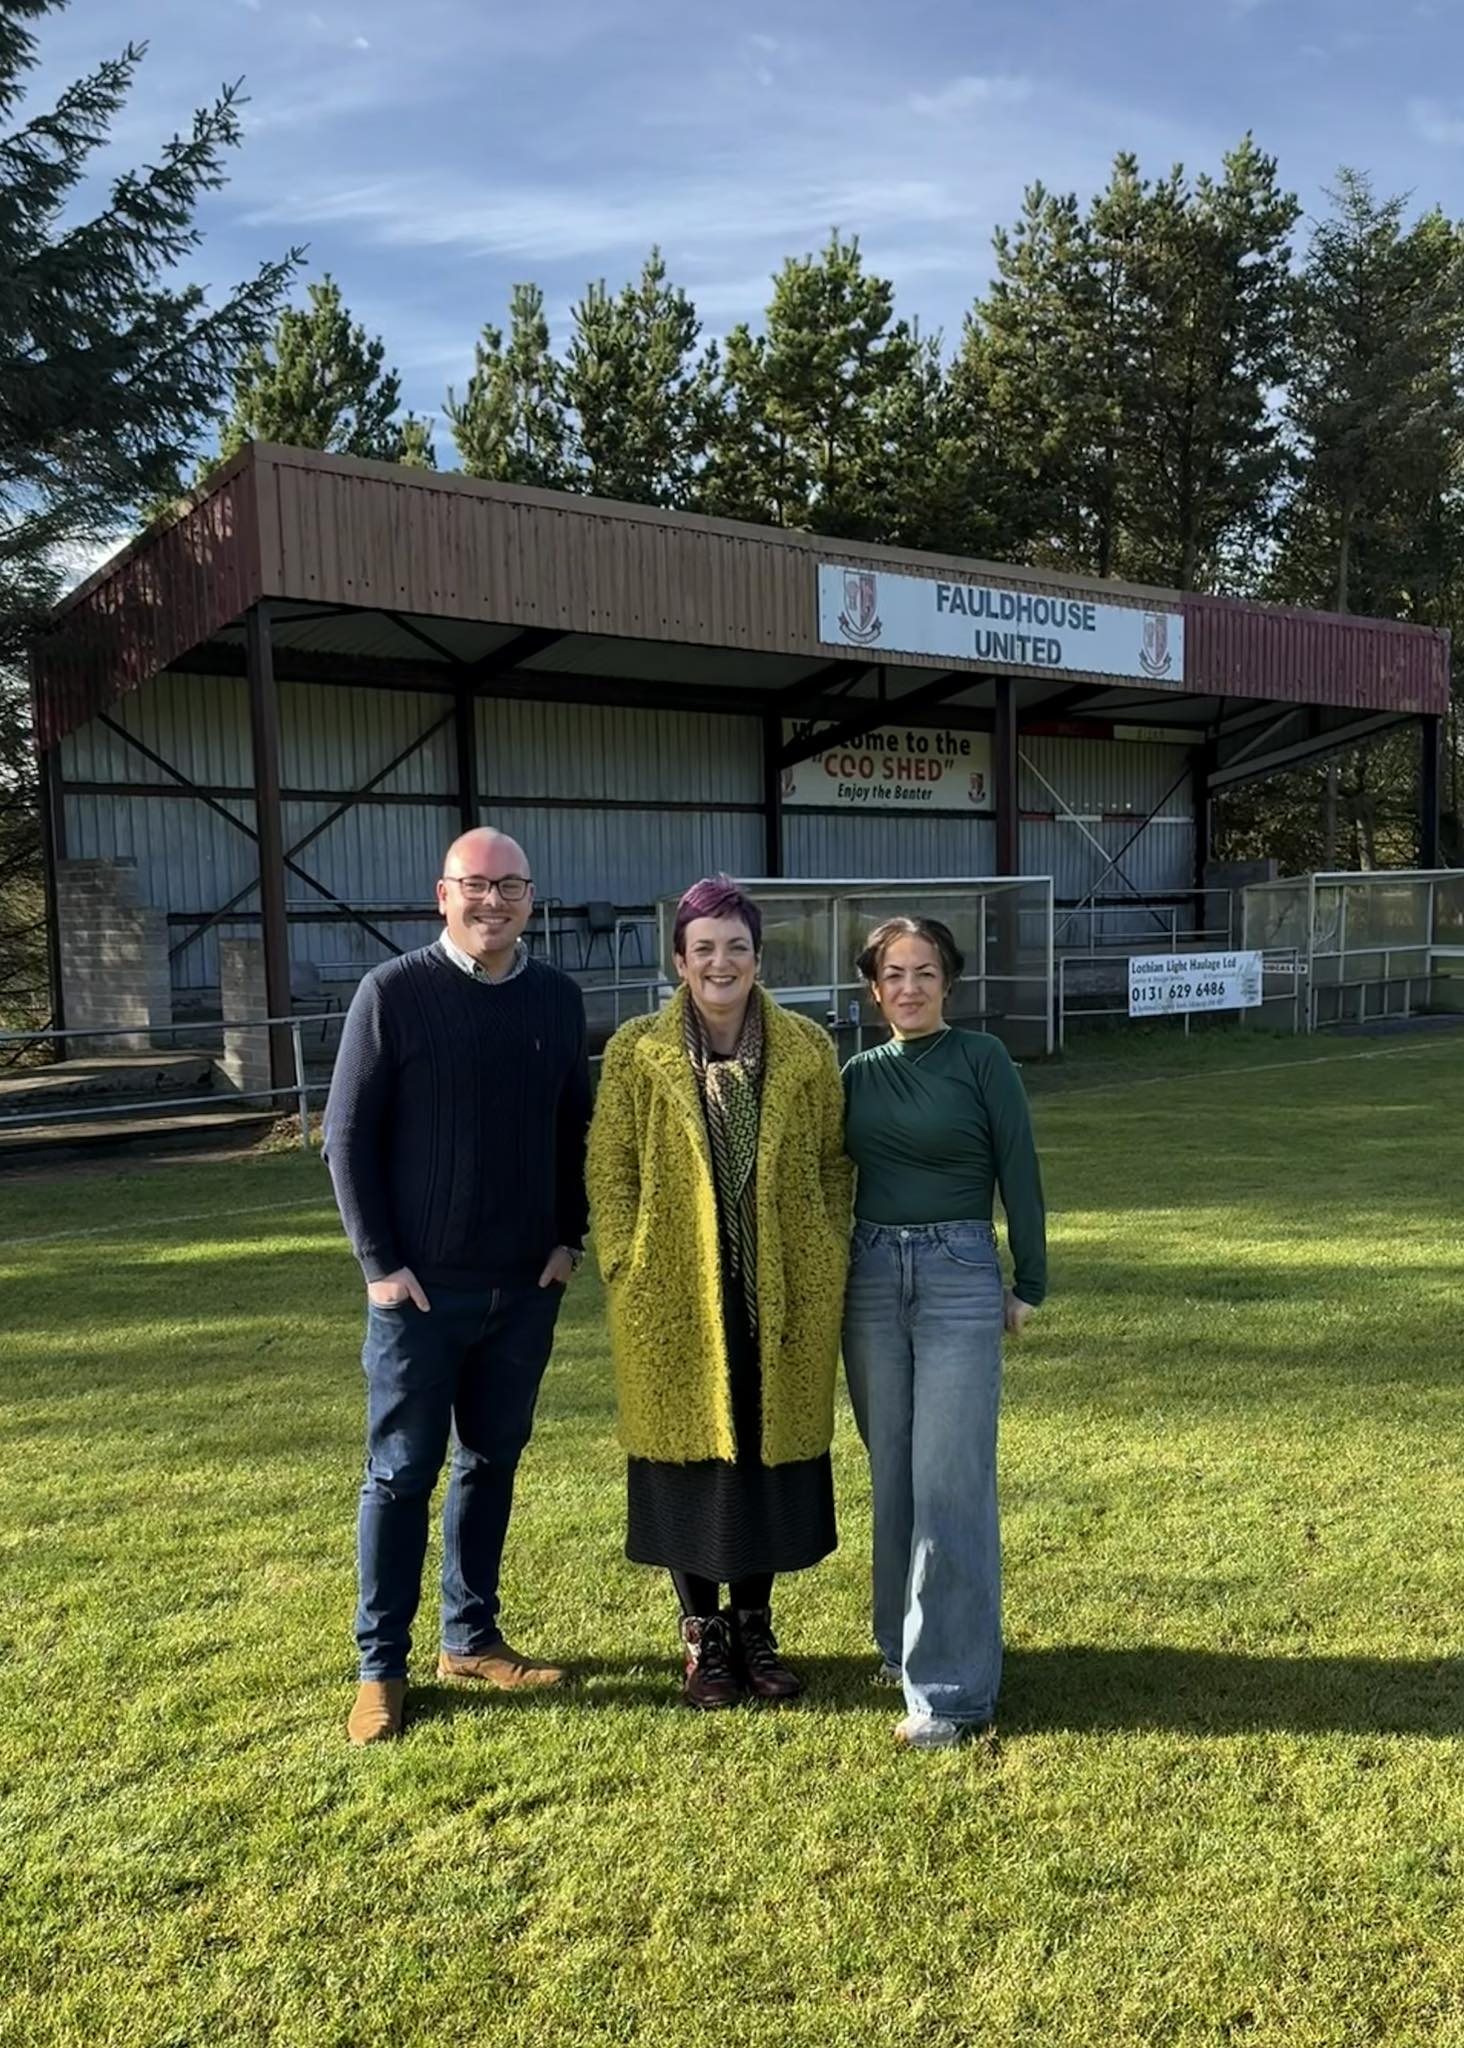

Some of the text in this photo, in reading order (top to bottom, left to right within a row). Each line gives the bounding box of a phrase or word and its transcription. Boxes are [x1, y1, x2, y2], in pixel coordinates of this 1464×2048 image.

[936, 584, 1096, 632] FAULDHOUSE
[974, 630, 1062, 665] UNITED
[906, 731, 929, 753] to
[936, 730, 971, 756] the
[837, 783, 932, 802] Enjoy the Banter
[1166, 959, 1188, 973] Light
[1189, 957, 1221, 972] Haulage
[1223, 956, 1237, 969] Ltd
[1131, 985, 1163, 1002] 0131
[1168, 983, 1192, 999] 629
[1195, 981, 1225, 997] 6486
